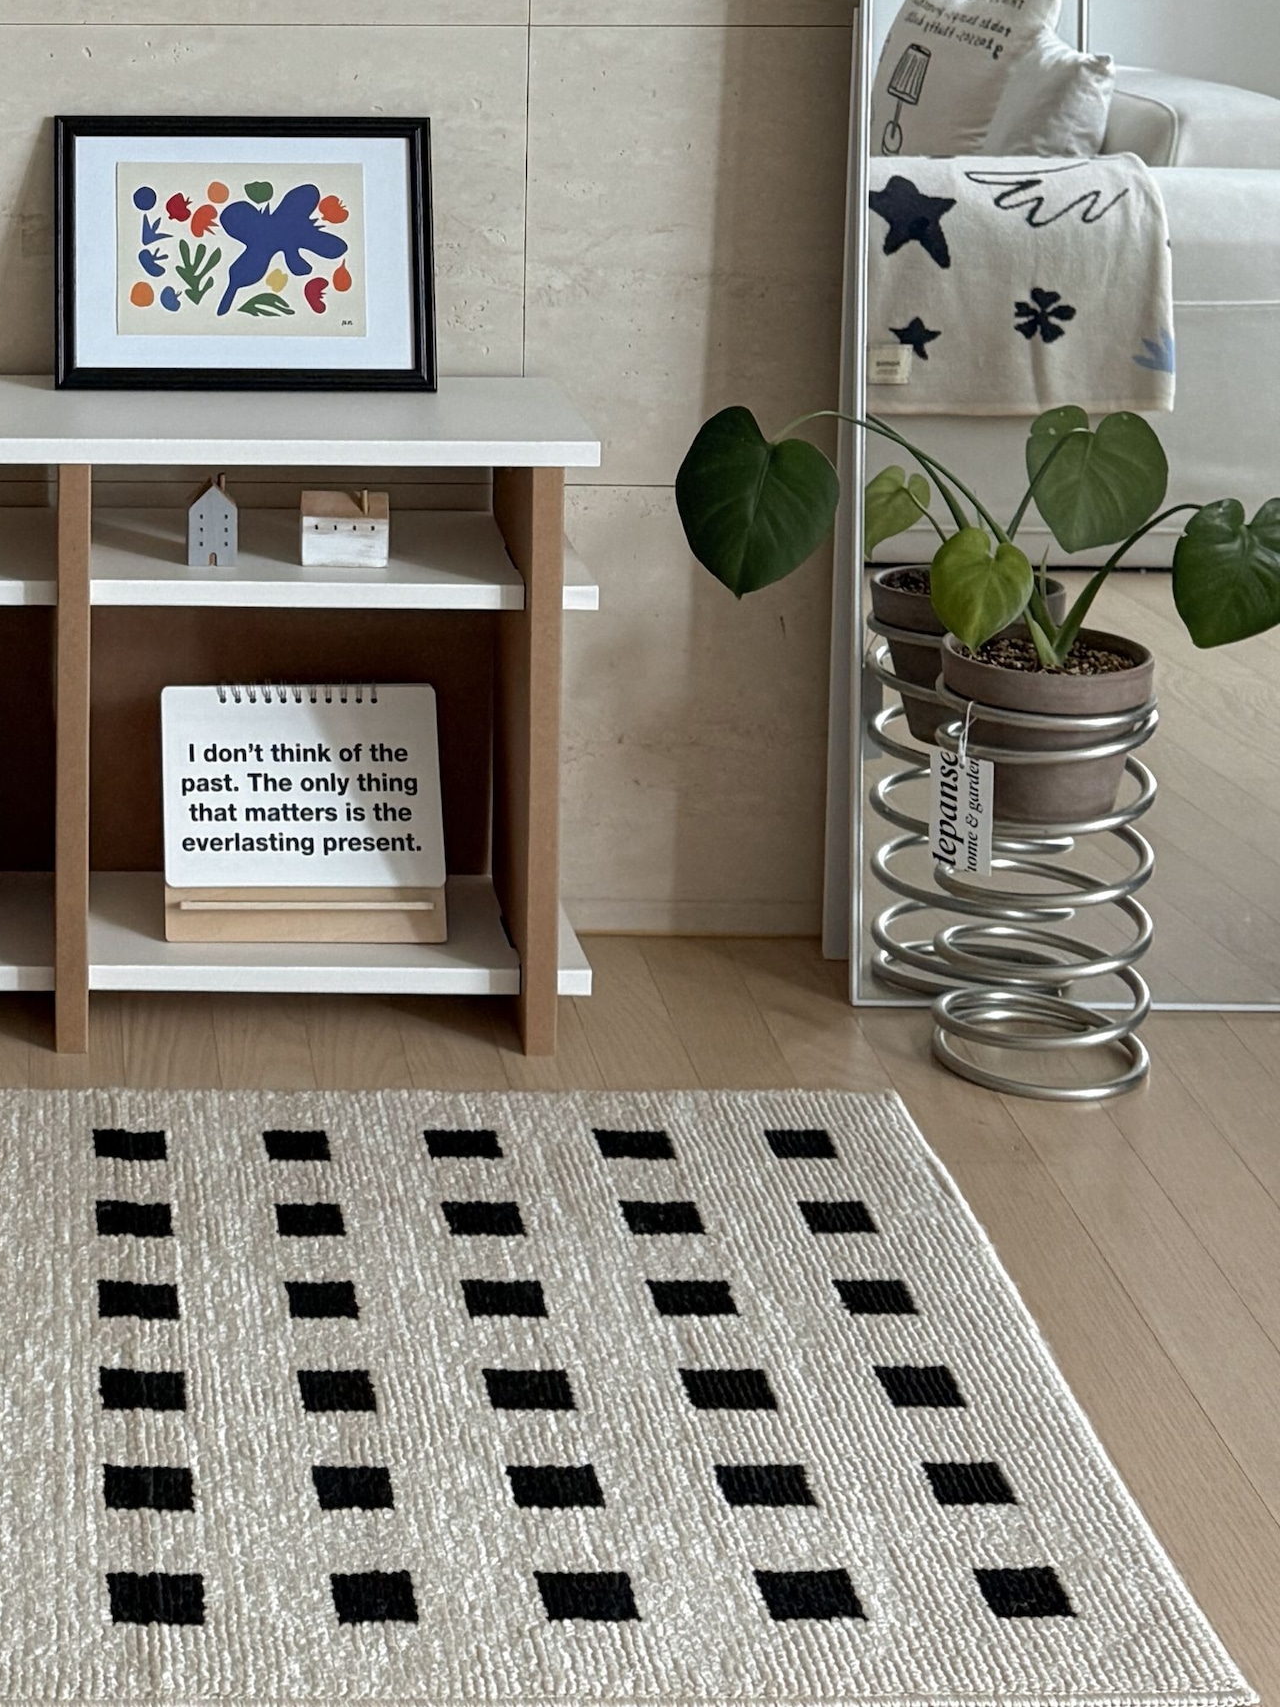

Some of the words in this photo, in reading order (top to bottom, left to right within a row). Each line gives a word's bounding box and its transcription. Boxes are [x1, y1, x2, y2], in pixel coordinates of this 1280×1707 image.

[188, 744, 195, 762] I
[203, 743, 264, 763] don’t
[270, 743, 332, 762] think
[338, 743, 362, 763] of
[369, 743, 408, 763] the
[181, 774, 239, 796] past.
[247, 773, 293, 792] The
[300, 773, 350, 796] only
[356, 773, 418, 796] thing
[188, 803, 237, 822] that
[245, 803, 338, 822] matters
[345, 803, 366, 822] is
[372, 803, 412, 822] the
[965, 813, 979, 828] &
[182, 833, 315, 855] everlasting
[323, 833, 422, 855] present.
